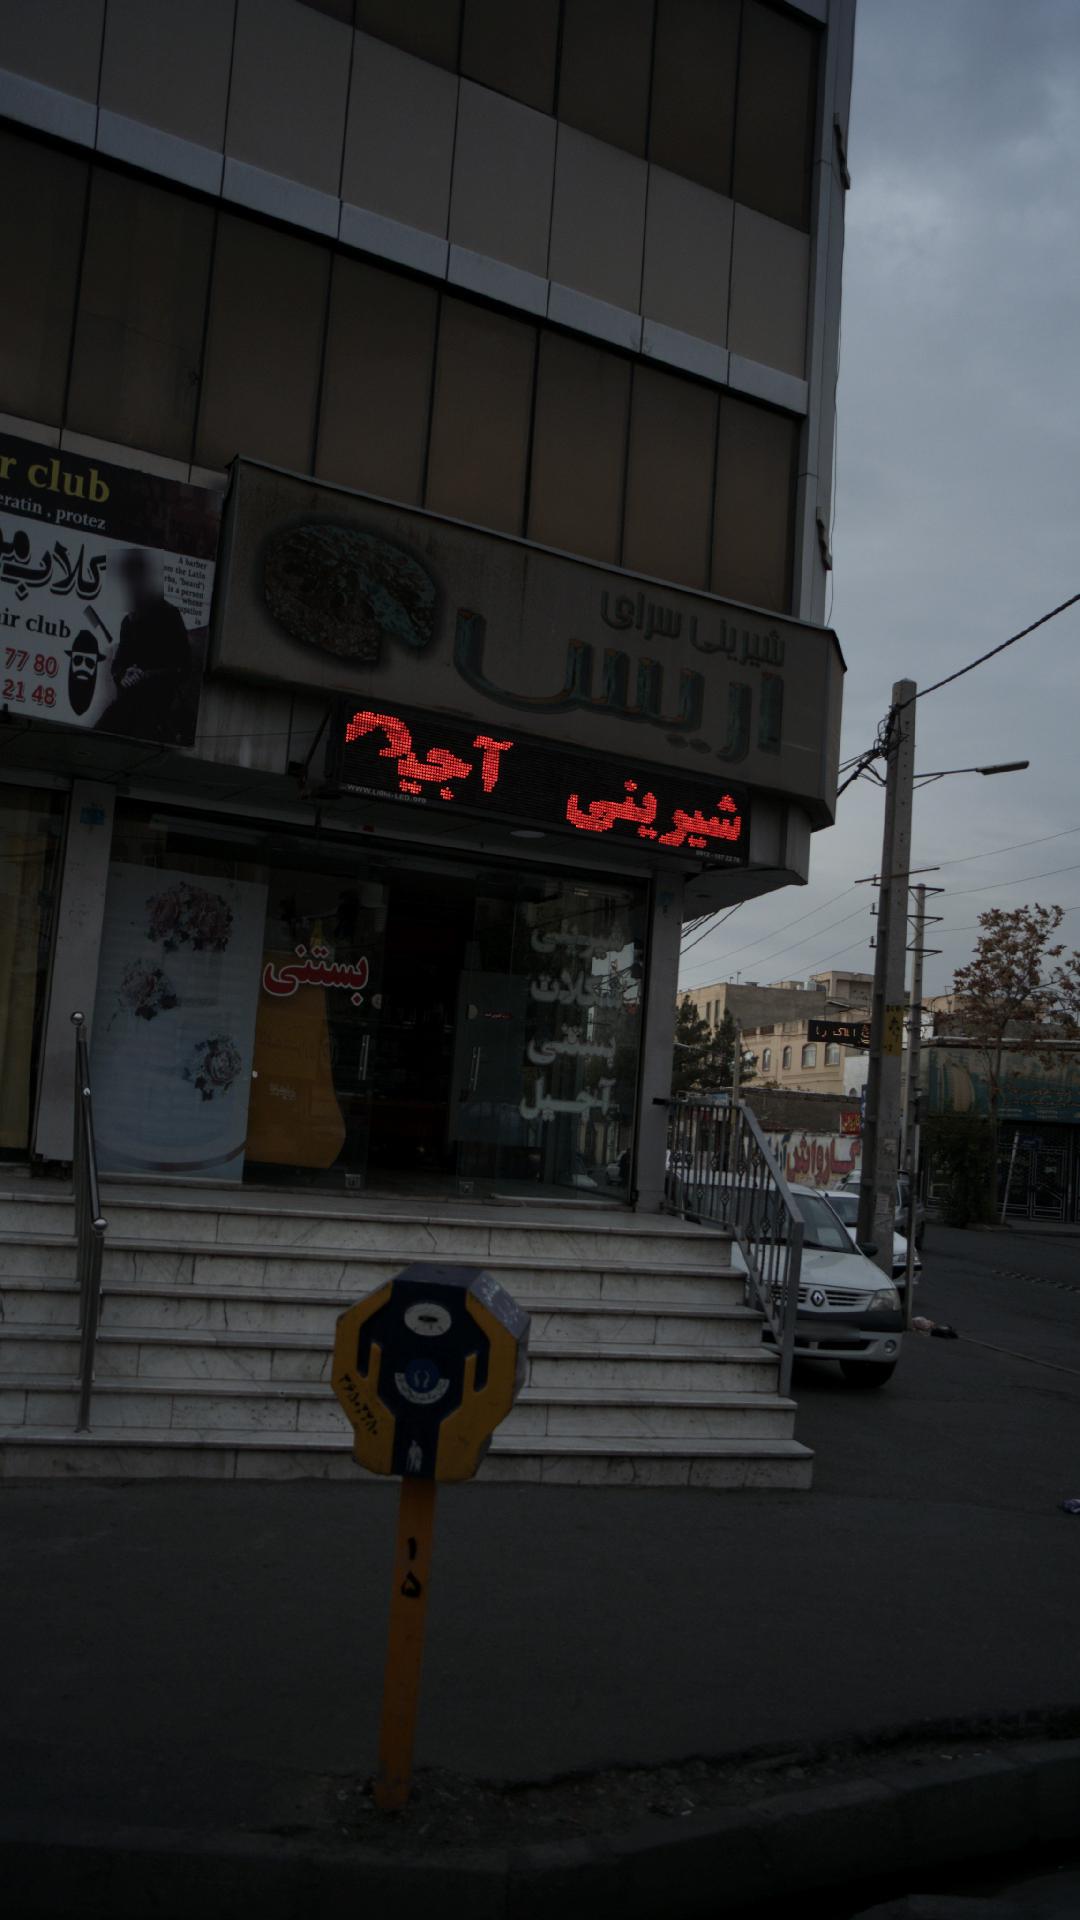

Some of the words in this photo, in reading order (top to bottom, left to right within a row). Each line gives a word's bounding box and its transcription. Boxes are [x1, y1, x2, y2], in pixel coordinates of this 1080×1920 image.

[26, 456, 111, 503] club
[55, 508, 107, 530] protez
[185, 558, 207, 570] barber
[181, 588, 204, 600] person
[26, 614, 71, 638] club
[601, 601, 682, 650] سرای
[5, 647, 30, 672] 77
[33, 653, 58, 678] 80
[690, 625, 785, 678] شیرینی
[2, 678, 25, 703] 21
[31, 684, 57, 708] 48
[263, 944, 369, 1007] بستنی
[527, 1023, 616, 1069] بستنی
[519, 1075, 617, 1122] آجیل
